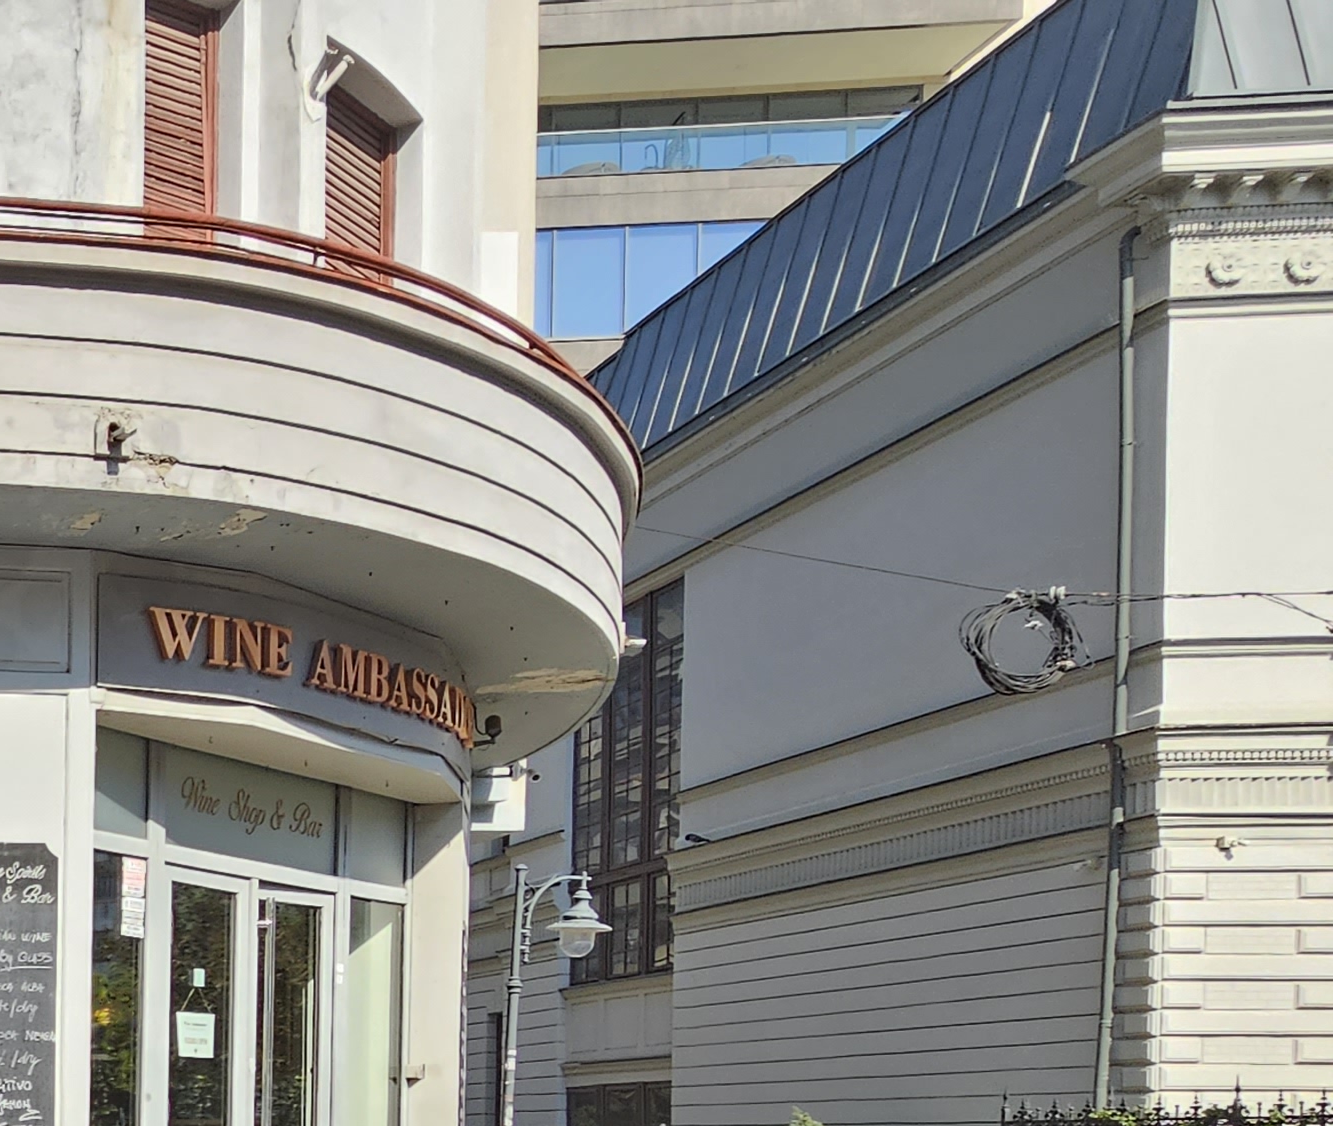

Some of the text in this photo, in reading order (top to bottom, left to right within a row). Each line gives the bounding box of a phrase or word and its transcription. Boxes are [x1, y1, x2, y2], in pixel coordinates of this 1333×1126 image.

[148, 606, 293, 677] WINE
[181, 776, 324, 838] Wine Shop & Bar
[2, 886, 17, 903] &
[21, 884, 55, 904] Bar
